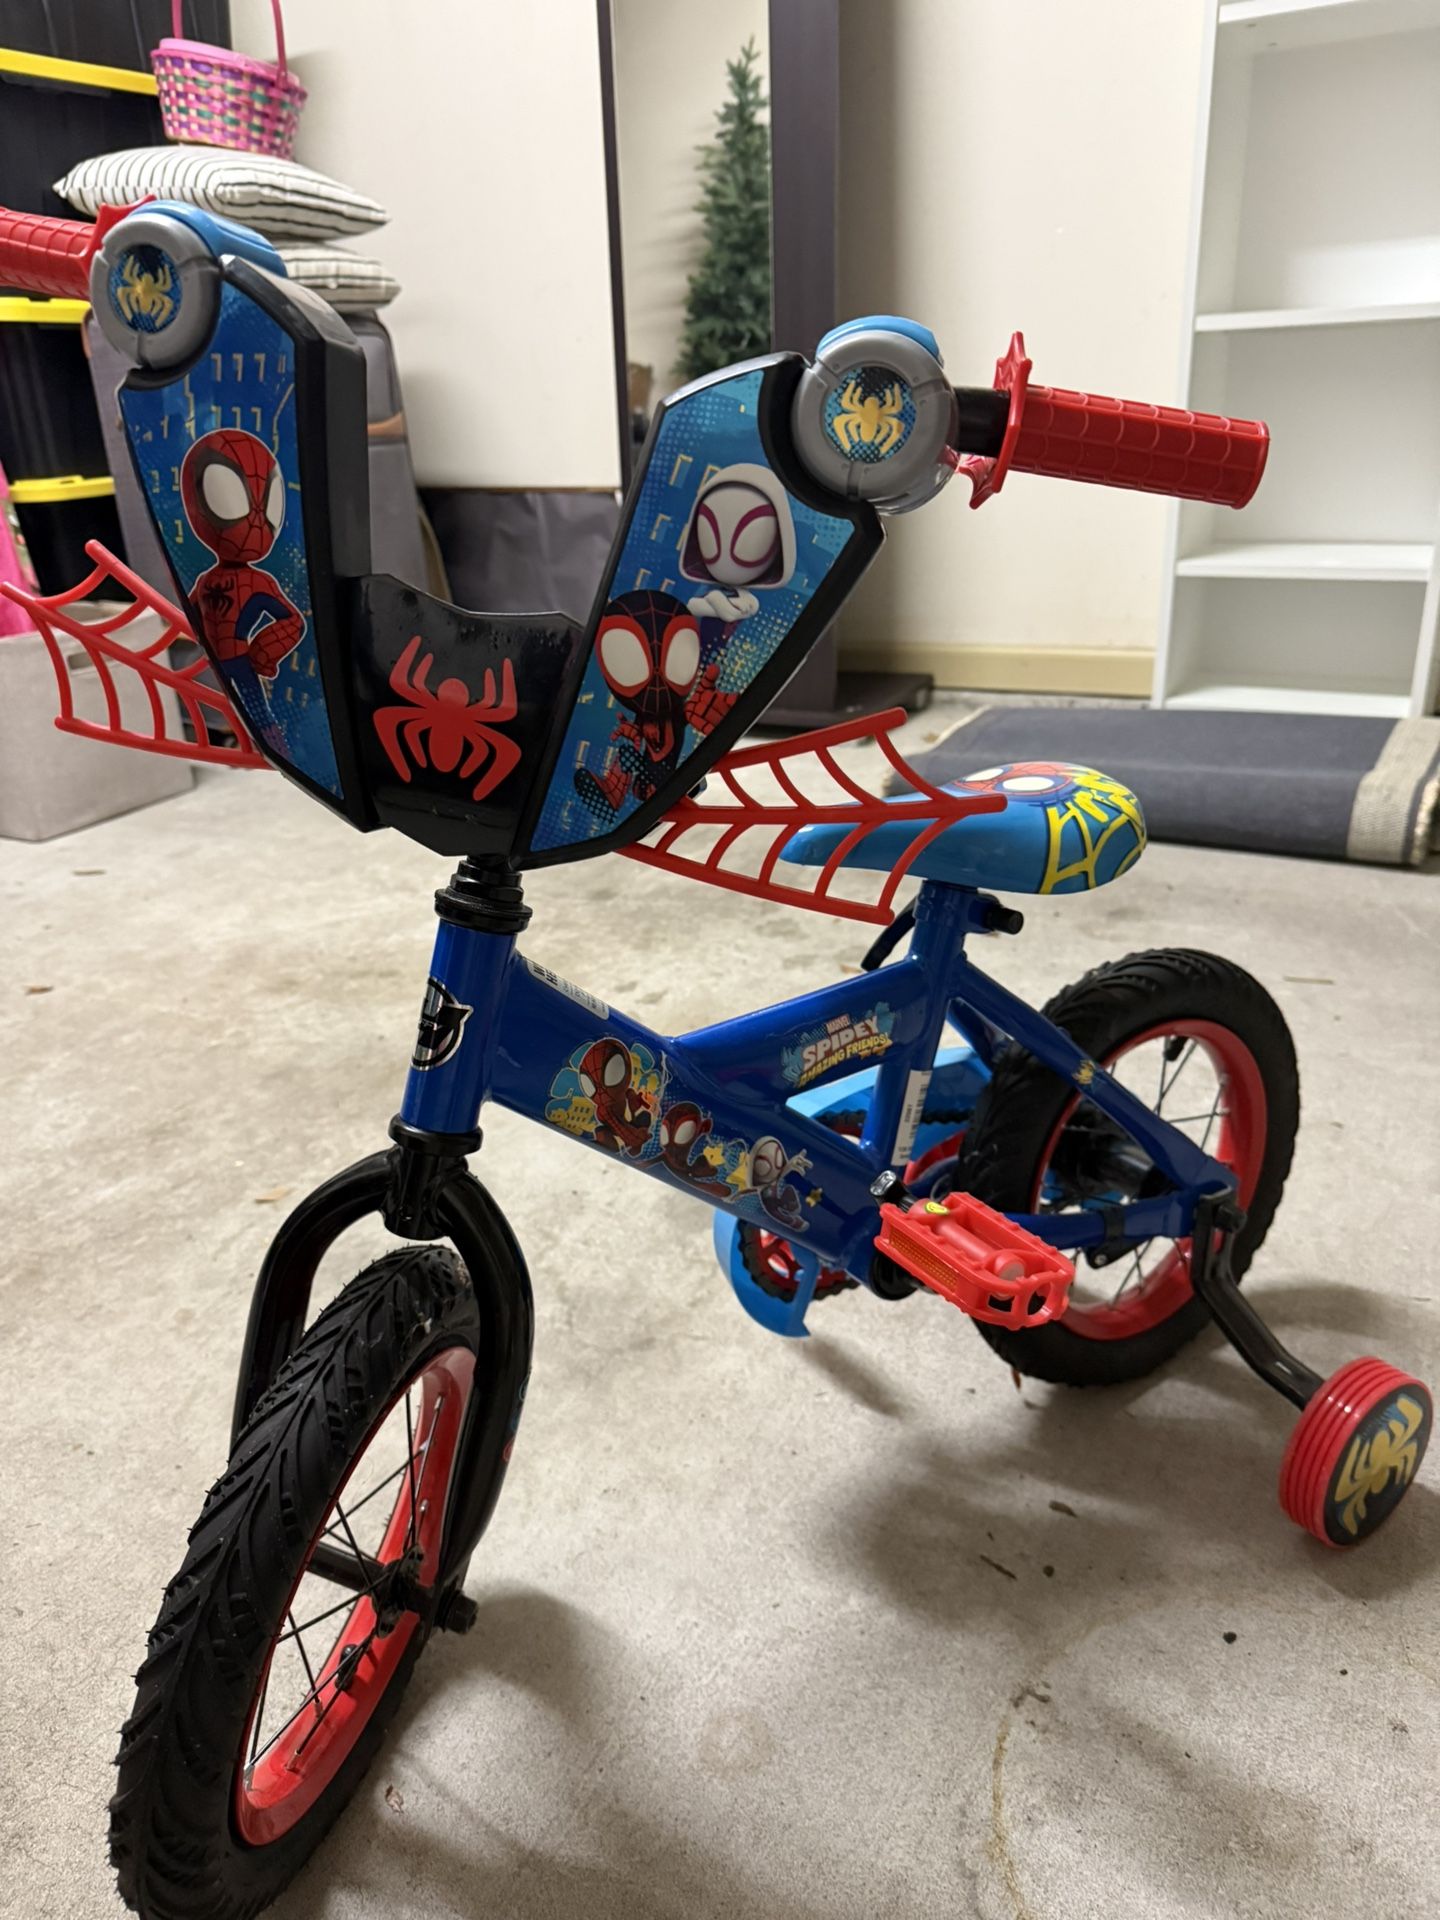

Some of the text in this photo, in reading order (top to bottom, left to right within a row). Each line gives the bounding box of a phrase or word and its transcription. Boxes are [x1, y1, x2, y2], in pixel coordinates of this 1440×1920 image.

[798, 1032, 890, 1088] AMAZING FRIENDS!
[802, 1015, 880, 1071] SPIDEY
